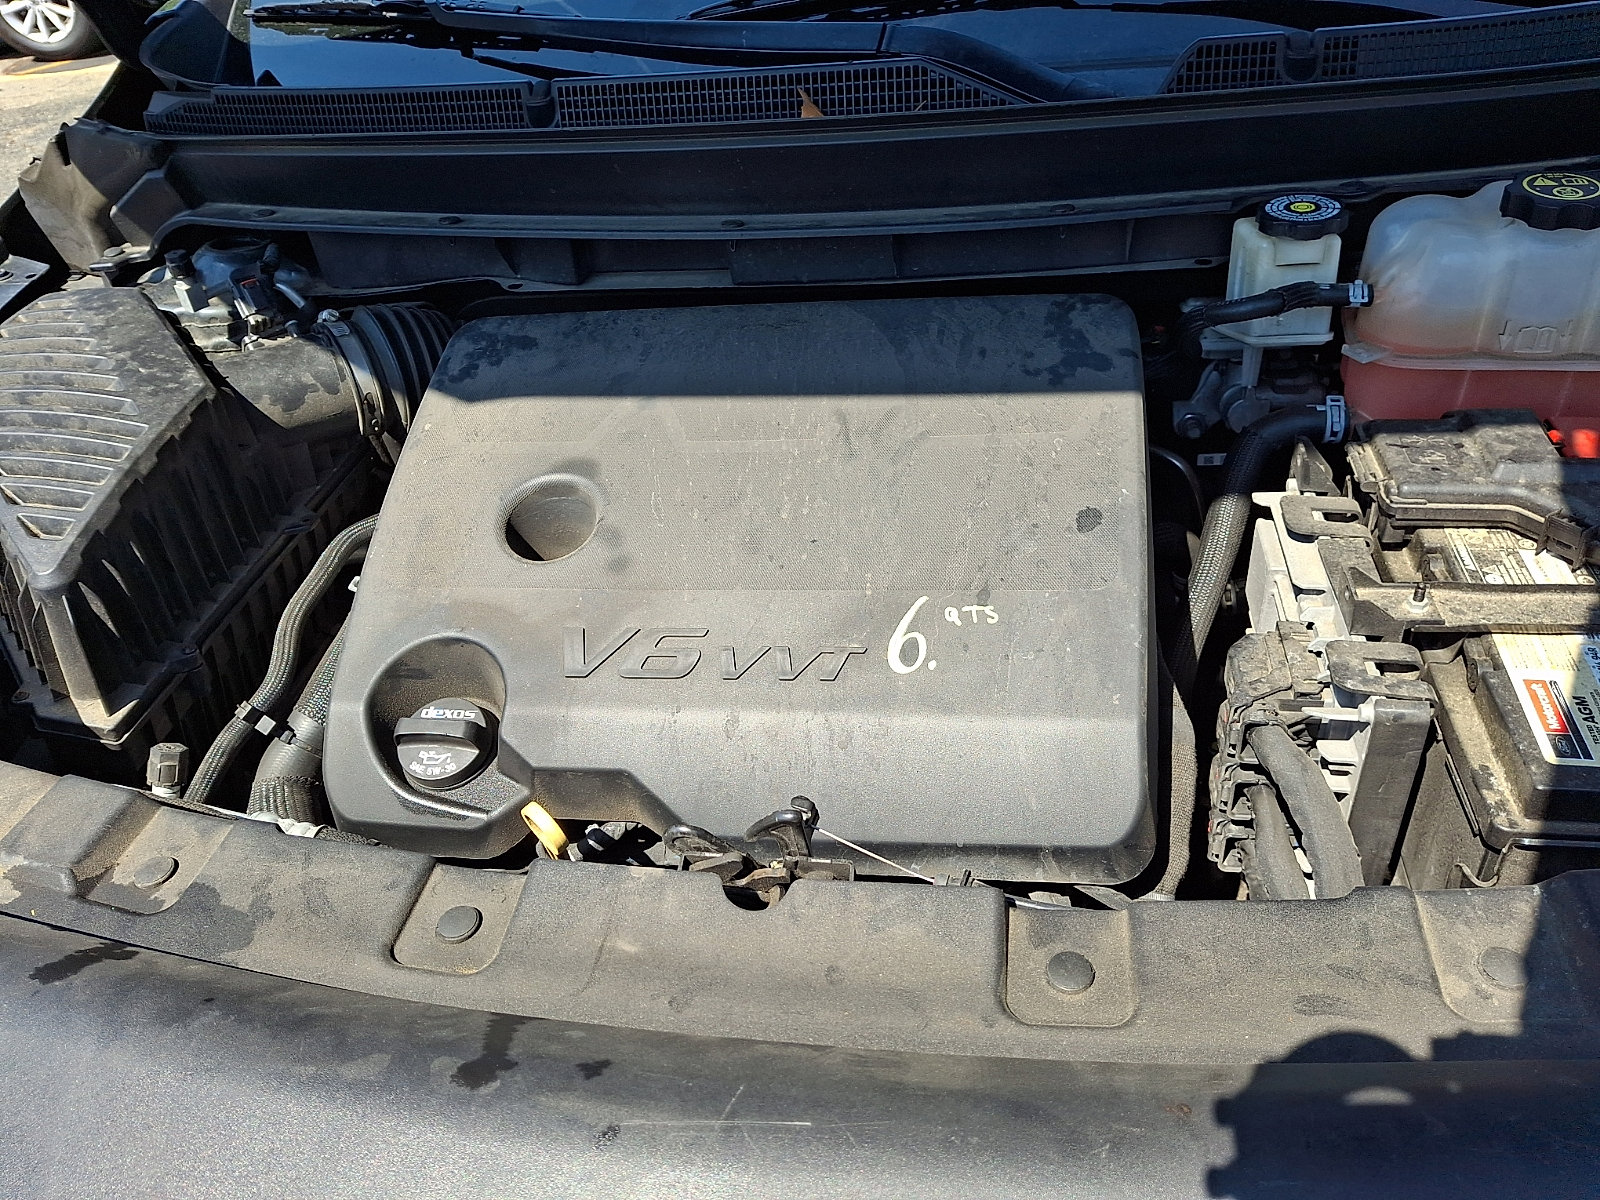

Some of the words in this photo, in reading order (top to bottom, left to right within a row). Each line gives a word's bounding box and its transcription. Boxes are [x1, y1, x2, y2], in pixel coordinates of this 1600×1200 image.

[563, 627, 710, 679] V6
[720, 645, 868, 681] VVT
[420, 706, 479, 719] dexos
[1530, 683, 1562, 730] Motorcraft
[1572, 695, 1599, 725] AGM
[409, 761, 425, 774] SAE
[426, 763, 457, 776] 5W-30
